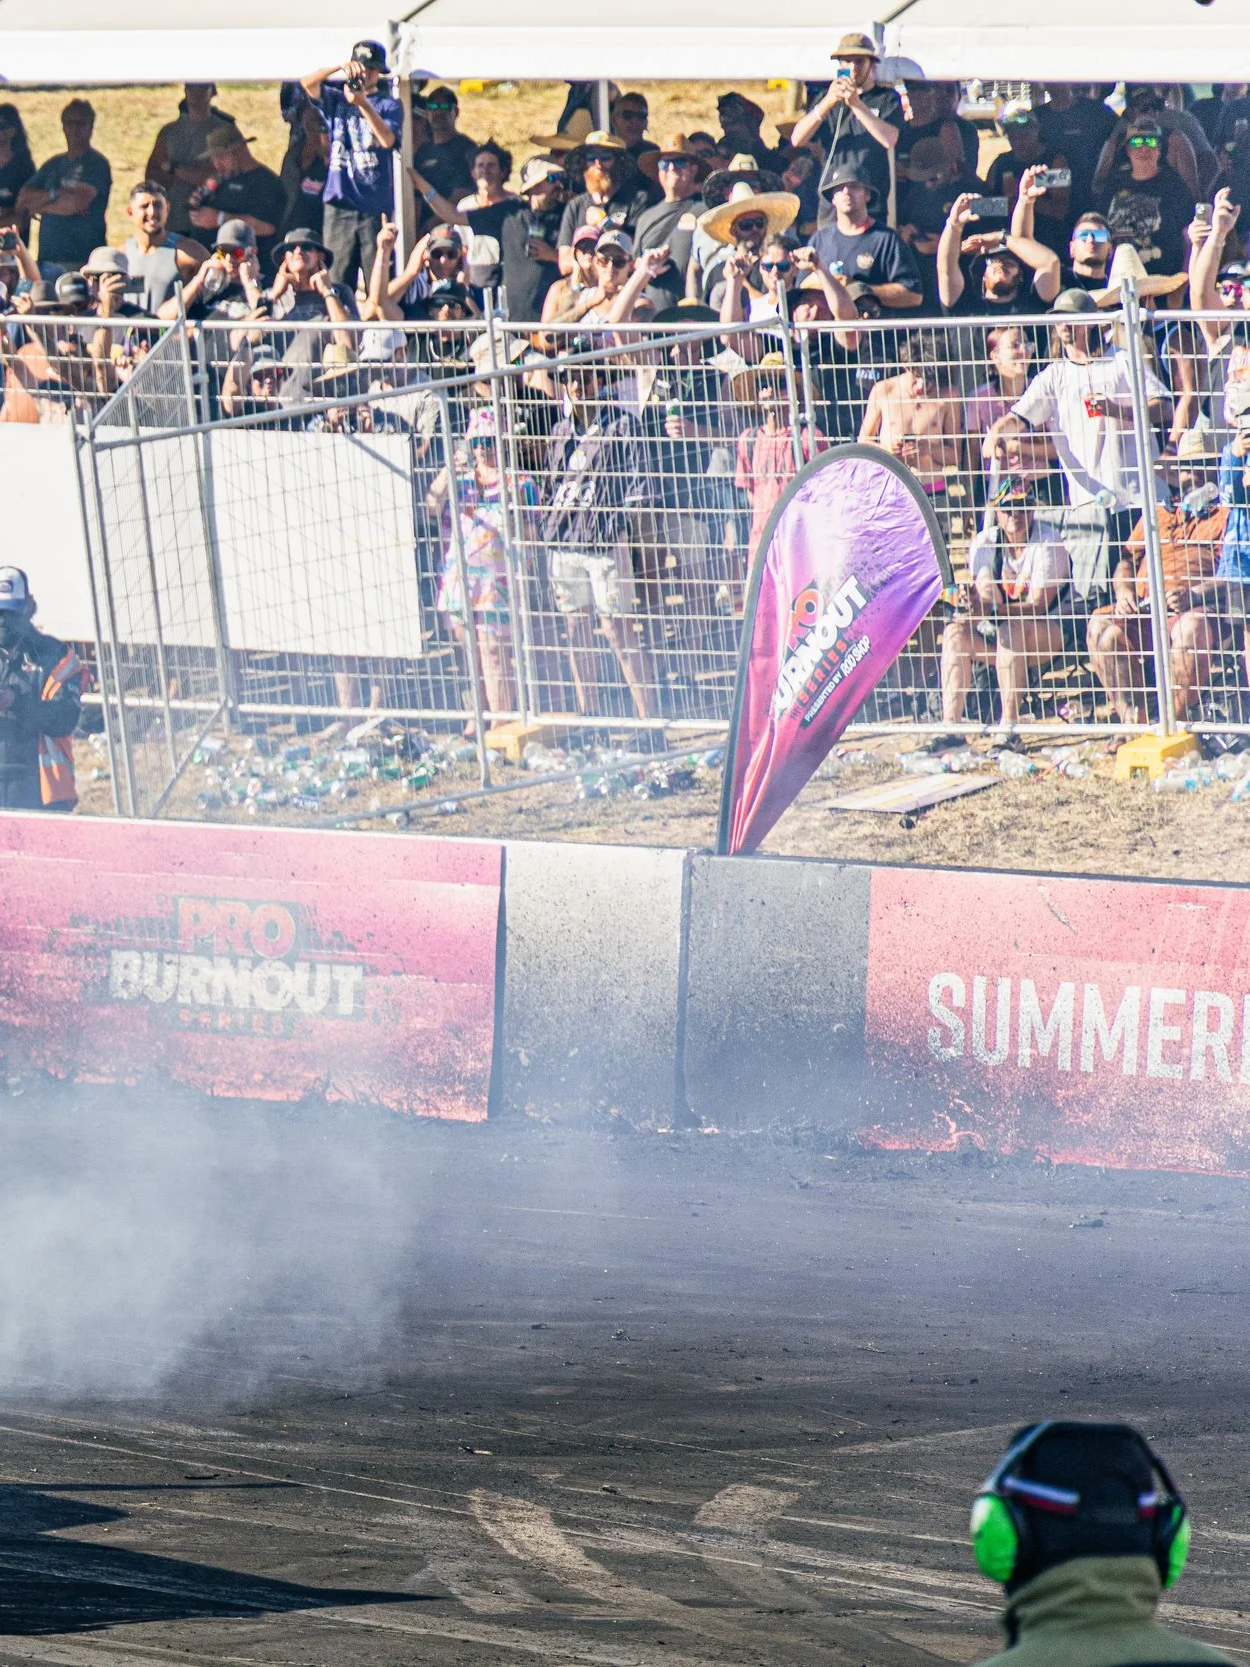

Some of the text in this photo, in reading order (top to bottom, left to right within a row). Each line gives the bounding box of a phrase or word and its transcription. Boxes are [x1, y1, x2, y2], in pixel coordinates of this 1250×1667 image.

[774, 574, 867, 711] URNOUT
[798, 639, 847, 704] SERIES
[804, 680, 836, 722] PRESENTED
[833, 672, 843, 684] BY
[854, 635, 871, 660] SHOP
[177, 897, 298, 959] PRO
[109, 948, 366, 1016] BURNOUT
[927, 972, 1250, 1086] SUMMER
